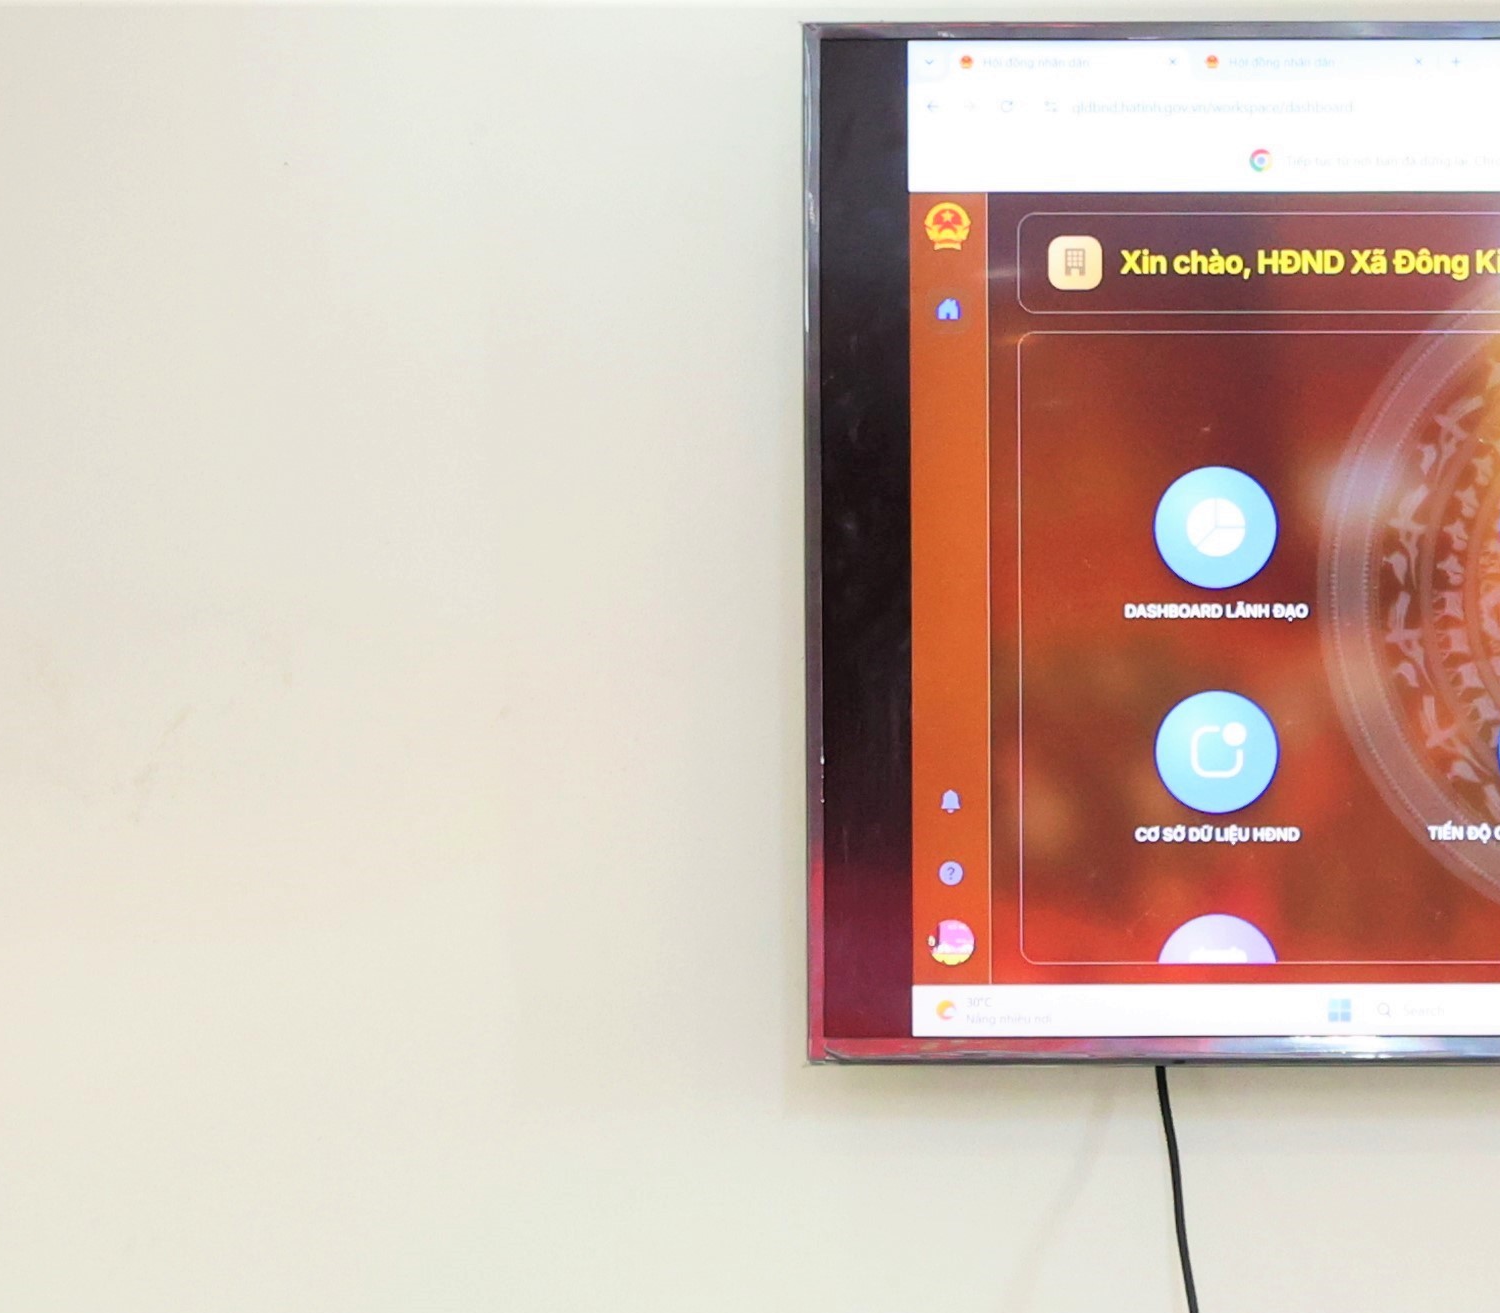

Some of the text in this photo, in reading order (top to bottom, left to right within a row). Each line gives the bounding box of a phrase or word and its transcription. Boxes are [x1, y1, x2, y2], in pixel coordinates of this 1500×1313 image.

[1120, 248, 1167, 275] Xin
[1173, 248, 1251, 280] chào,
[1257, 249, 1345, 275] HĐND
[1350, 248, 1388, 275] Xã
[1392, 247, 1470, 281] Đông
[1124, 600, 1309, 622] DASHBOARD LÃNH ĐẠO
[1214, 824, 1250, 846] LIỆU
[1252, 826, 1301, 842] HĐND
[1466, 822, 1492, 844] ĐỘ
